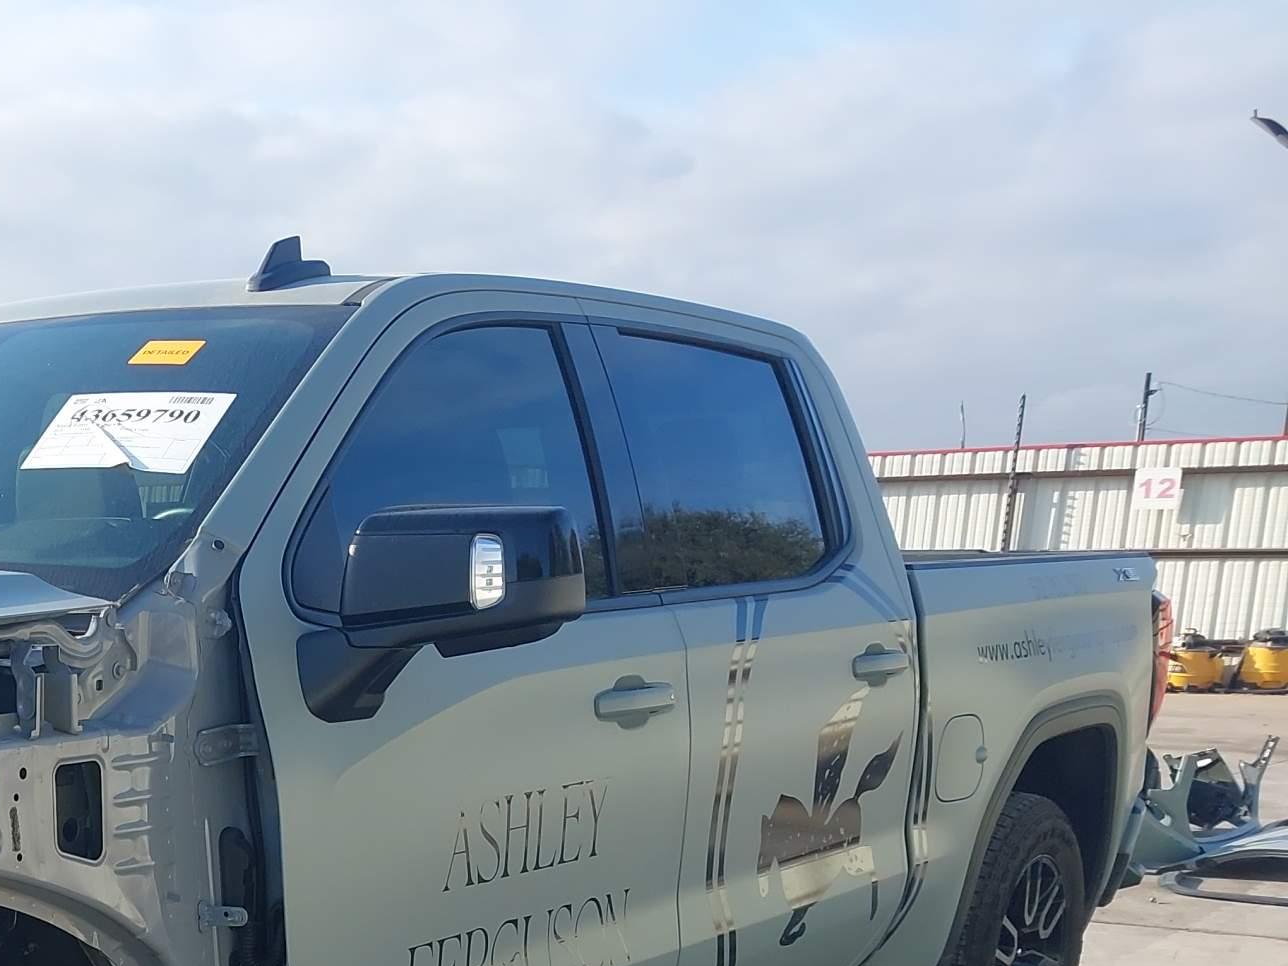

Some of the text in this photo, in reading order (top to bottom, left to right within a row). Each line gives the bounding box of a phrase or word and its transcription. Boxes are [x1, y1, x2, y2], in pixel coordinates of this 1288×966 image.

[71, 406, 201, 424] 43659790
[1138, 478, 1177, 499] 12
[441, 777, 611, 893] ASHLEY
